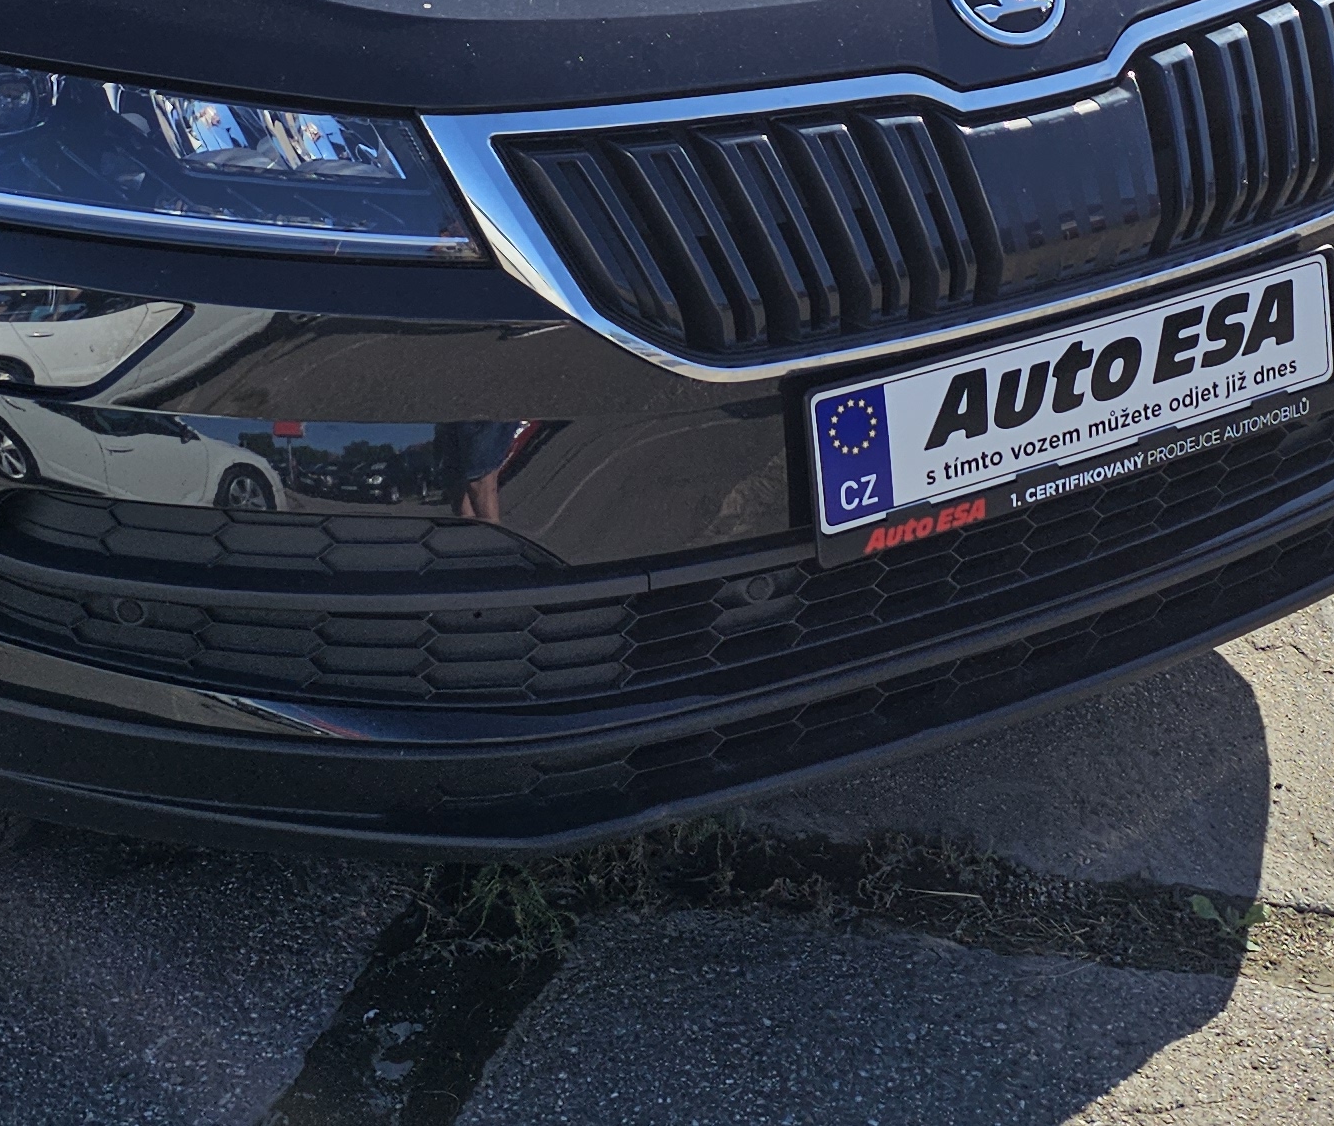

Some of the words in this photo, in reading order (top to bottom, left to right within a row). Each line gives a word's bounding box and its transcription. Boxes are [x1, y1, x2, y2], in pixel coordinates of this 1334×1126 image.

[1153, 278, 1295, 385] ESA
[926, 470, 937, 486] s
[944, 451, 1003, 481] tímto
[1011, 430, 1081, 461] vozem
[1088, 404, 1163, 439] můžete
[1169, 379, 1220, 412] odjet
[1224, 372, 1247, 400] již
[1254, 359, 1298, 386] dnes
[1010, 493, 1022, 508] 1.
[1025, 452, 1144, 504] CERTIFIKOVANÝ
[1147, 429, 1221, 466] PRODEJCE
[1224, 397, 1310, 441] AUTOMOBILŮ
[840, 474, 879, 511] CZ
[936, 498, 987, 534] ESA
